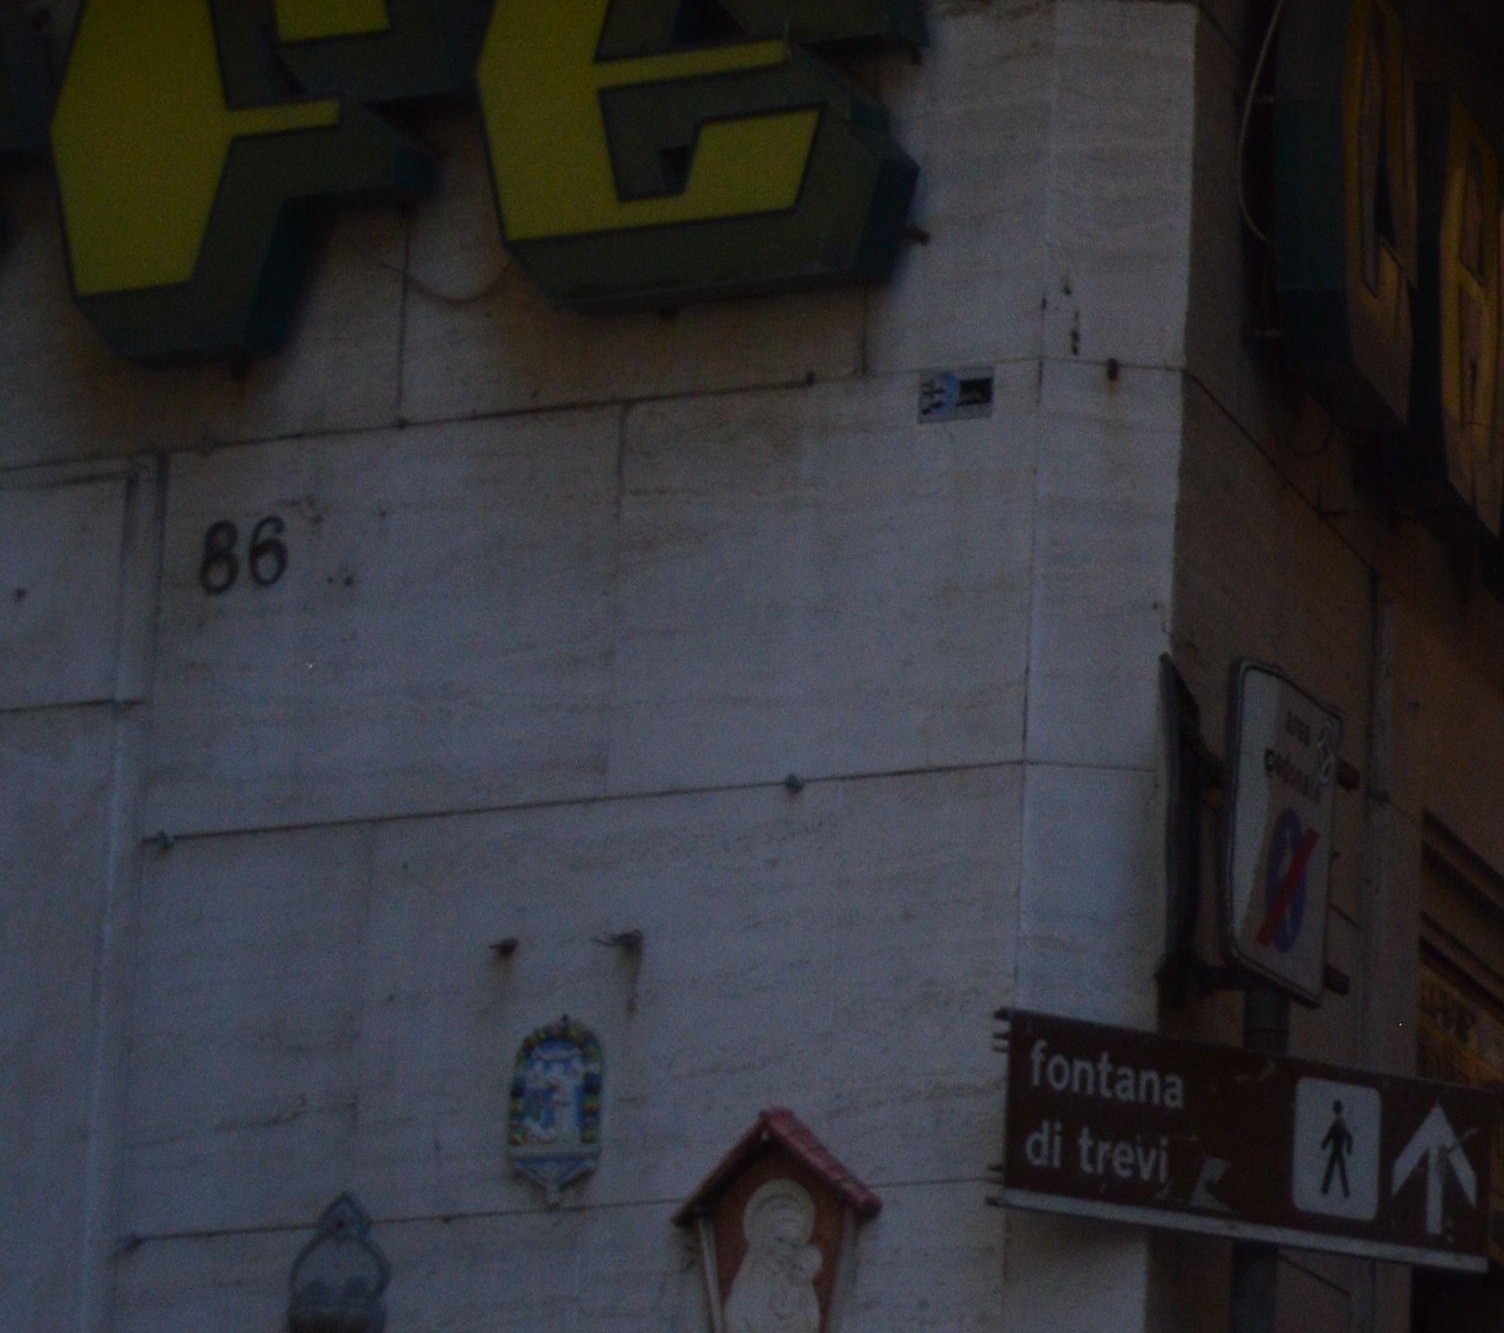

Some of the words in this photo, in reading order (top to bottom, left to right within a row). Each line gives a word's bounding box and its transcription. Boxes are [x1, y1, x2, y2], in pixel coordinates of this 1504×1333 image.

[198, 513, 291, 596] 86
[1029, 1038, 1186, 1111] fontana
[1024, 1119, 1063, 1168] di
[1076, 1125, 1171, 1185] trevi
